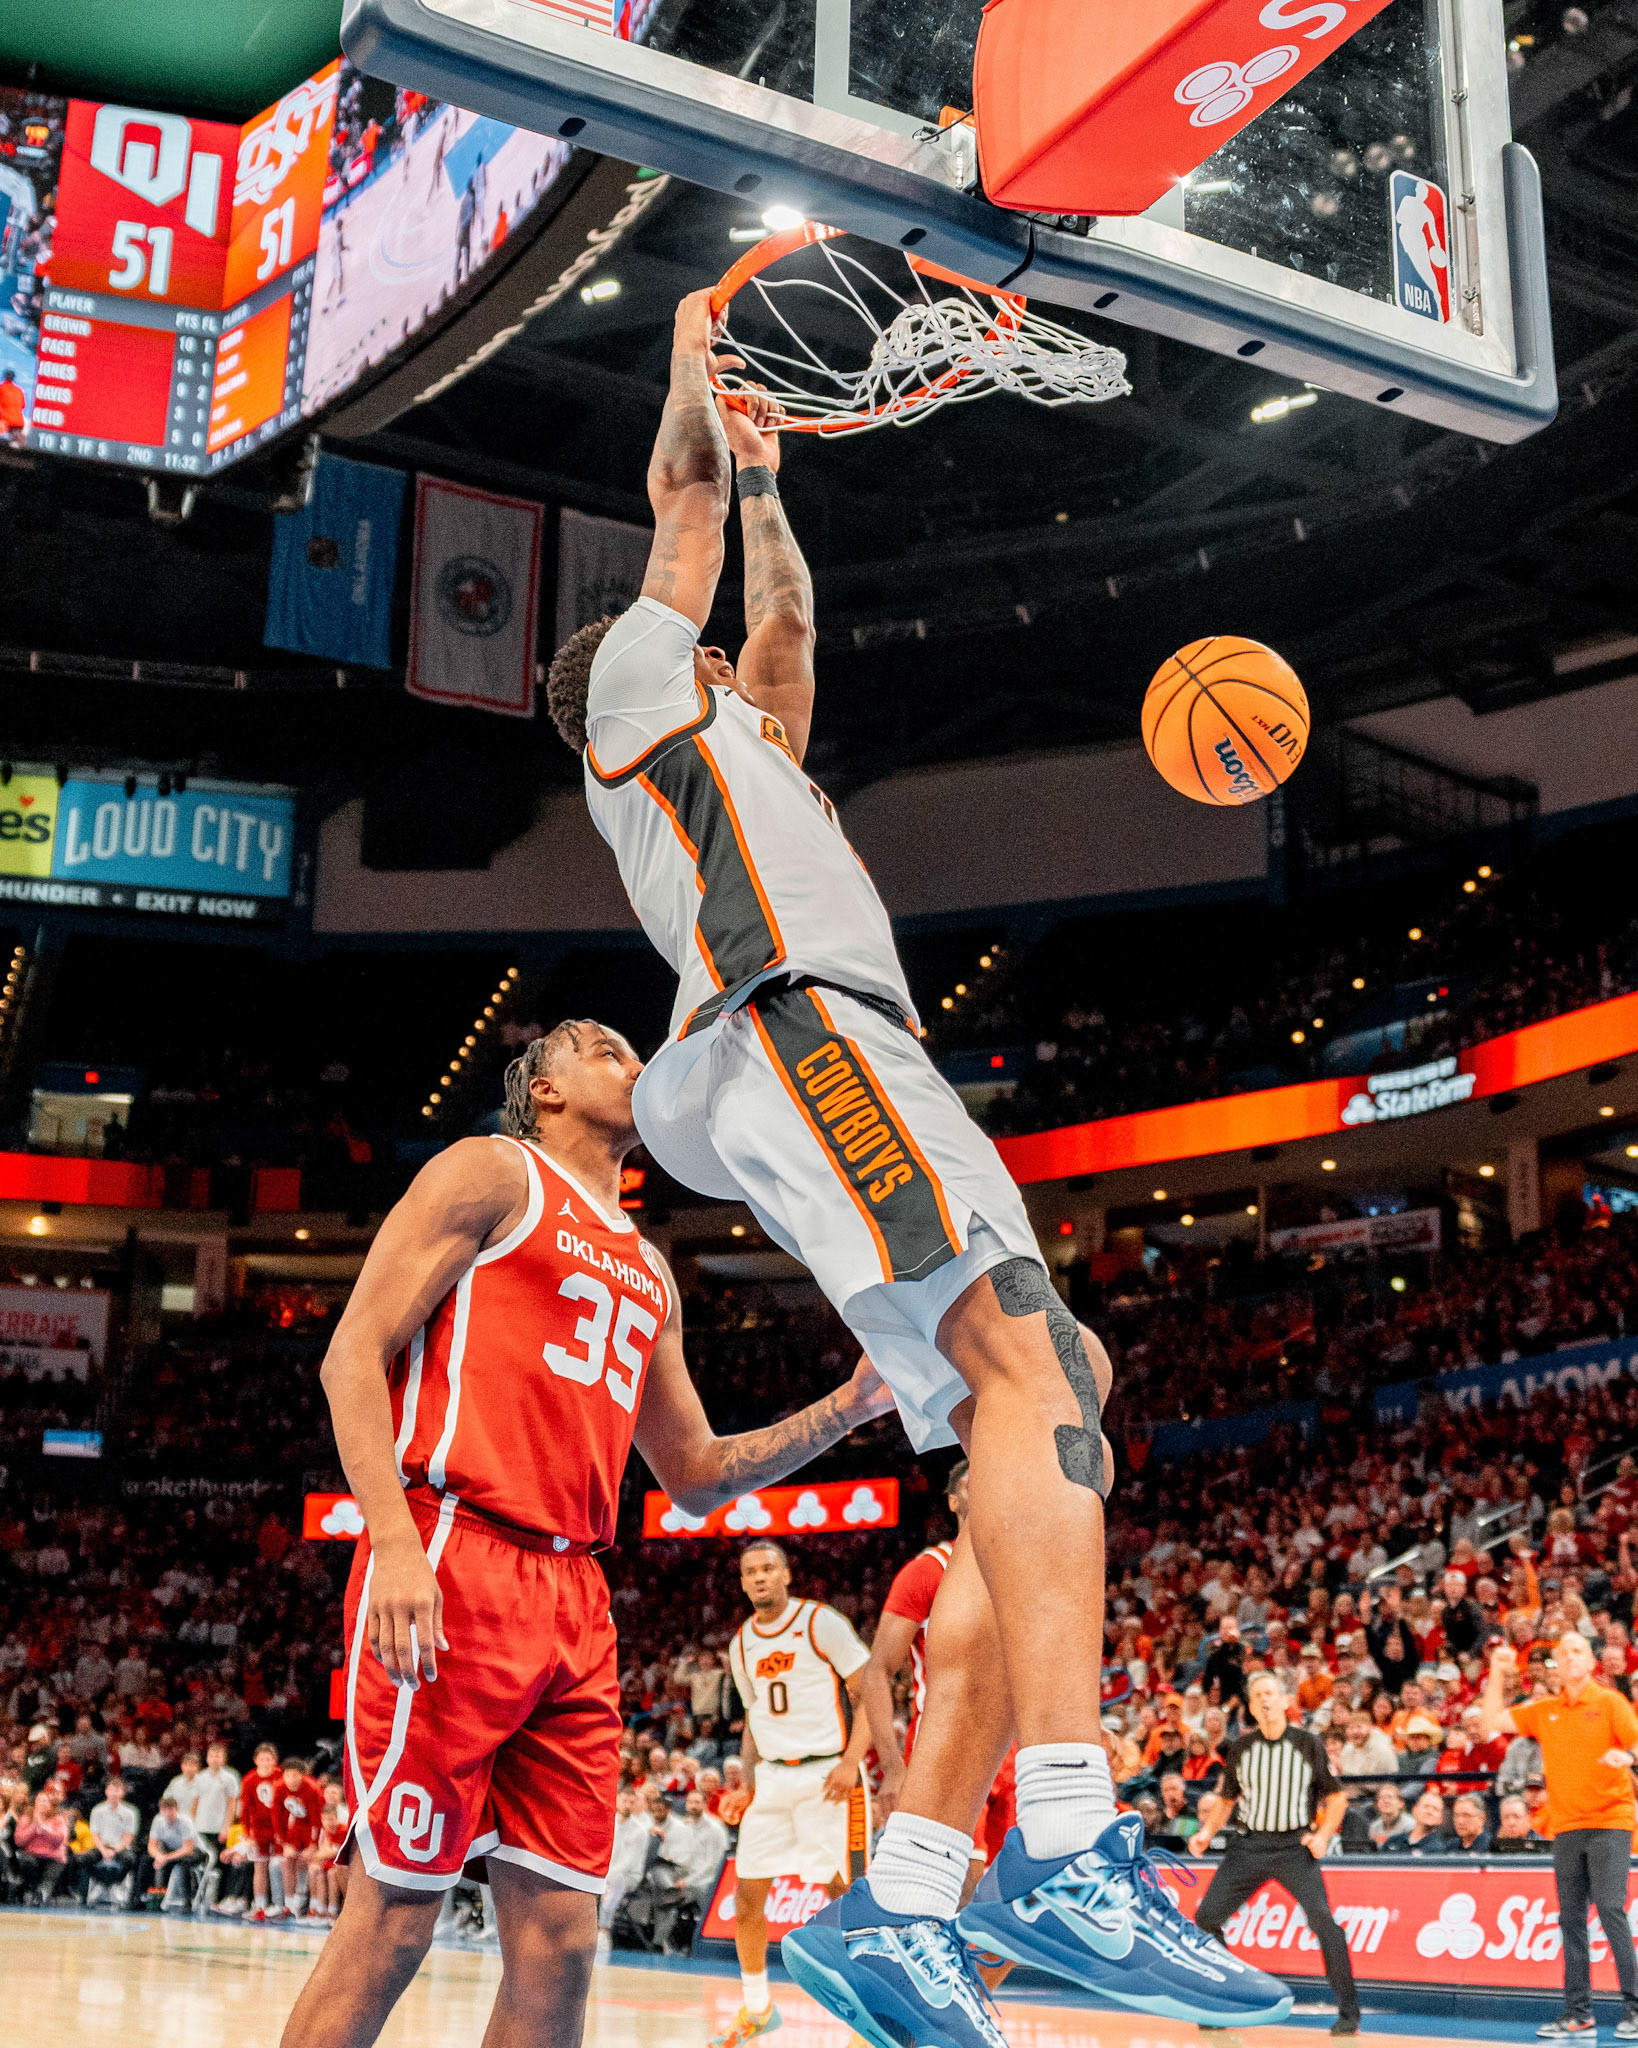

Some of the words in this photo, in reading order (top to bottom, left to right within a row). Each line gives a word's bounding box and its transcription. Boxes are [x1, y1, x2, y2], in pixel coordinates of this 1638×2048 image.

[108, 220, 173, 296] 51
[257, 197, 295, 280] 51
[48, 291, 96, 314] PLAYER
[175, 312, 201, 330] PTS
[201, 315, 219, 333] FL
[1404, 283, 1432, 314] NBA
[43, 314, 92, 337] BROWN
[37, 360, 78, 382] JONES
[197, 384, 209, 401] 2
[201, 361, 211, 378] 1
[32, 407, 64, 427] REID
[35, 383, 73, 404] DAVIS
[173, 405, 186, 422] 3
[38, 432, 56, 450] TO
[60, 435, 71, 452] 3
[77, 439, 94, 456] TF
[97, 441, 110, 458] 5
[126, 446, 155, 464] 2ND
[164, 452, 200, 471] 11:32
[1251, 715, 1270, 730] NXT
[63, 799, 177, 867] LOUD
[191, 804, 283, 881] CITY
[136, 892, 193, 914] EXIT
[198, 897, 258, 919] NOW
[796, 1040, 914, 1204] COWBOYS
[556, 1229, 664, 1314] OKLAHOMA
[542, 1271, 658, 1414] 35
[769, 1681, 789, 1716] 0
[387, 1781, 446, 1864] OU
